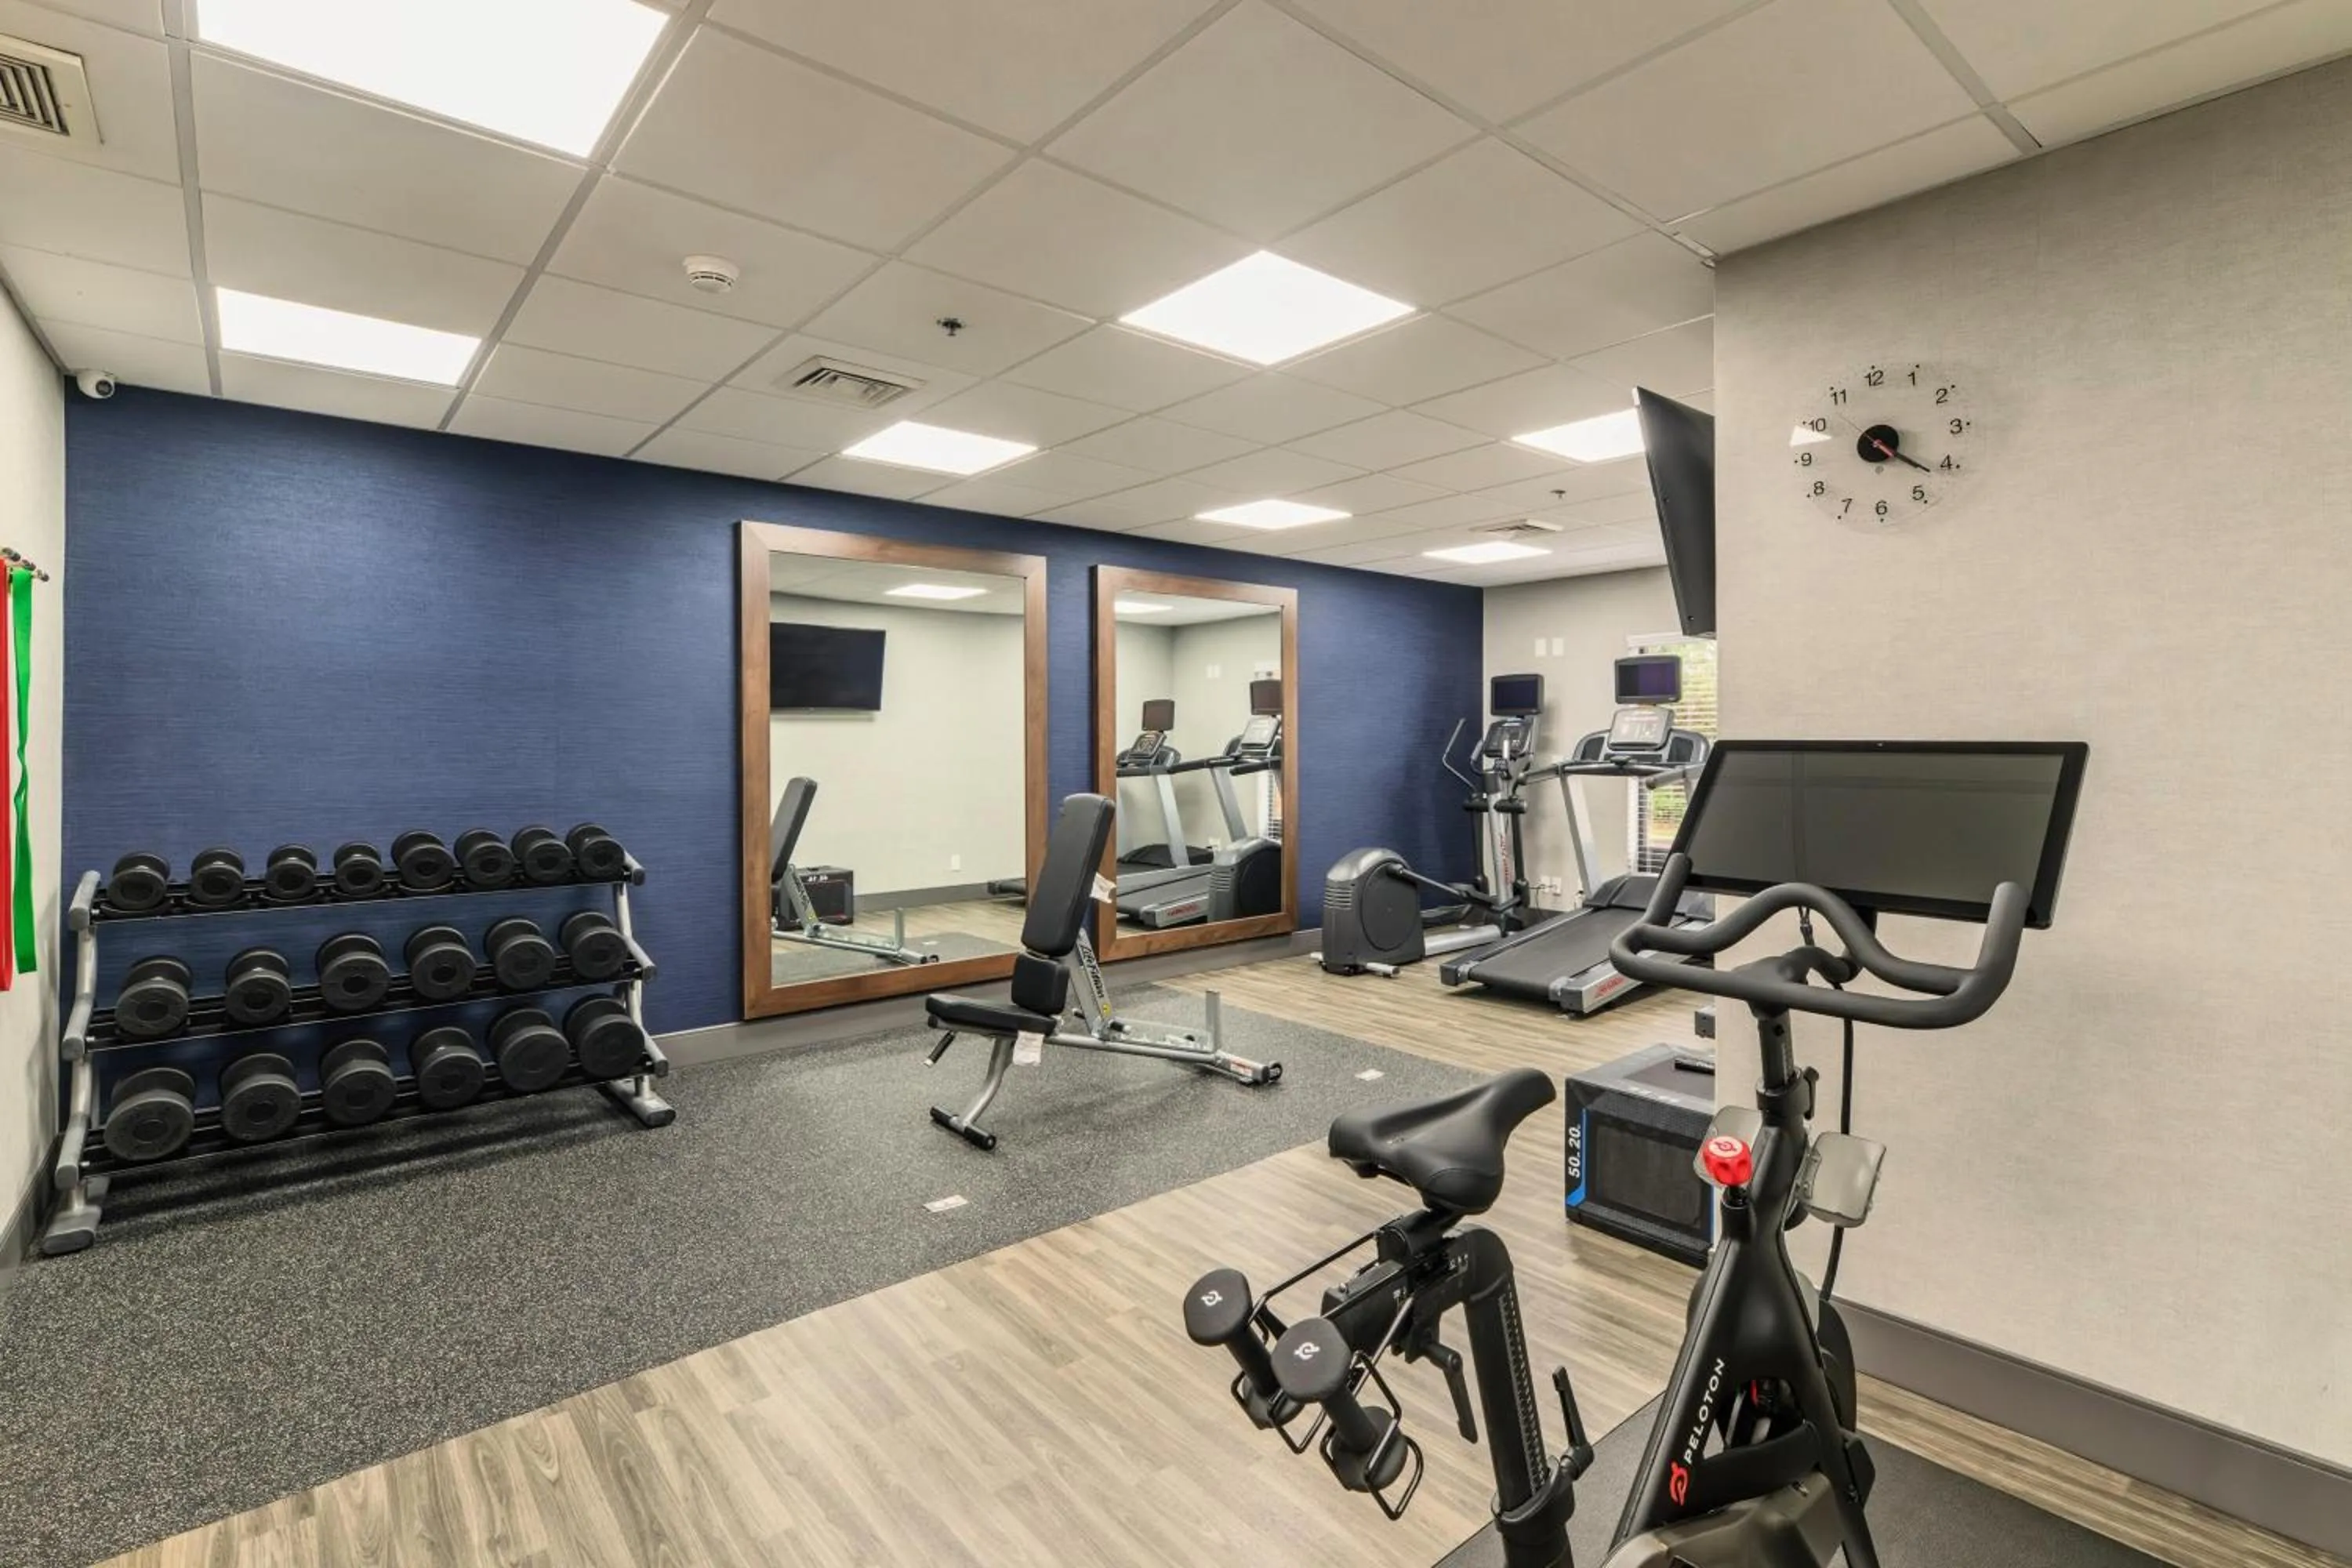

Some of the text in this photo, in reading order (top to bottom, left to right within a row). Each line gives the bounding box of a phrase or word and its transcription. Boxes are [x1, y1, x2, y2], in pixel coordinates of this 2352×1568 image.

[1864, 370, 1884, 387] 12
[1907, 372, 1915, 386] 1
[1830, 390, 1846, 405] 11
[1936, 388, 1947, 405] 2
[1809, 418, 1827, 432] 10
[1951, 419, 1962, 434] 3
[1801, 452, 1812, 466] 9
[1940, 455, 1952, 470] 4
[1813, 481, 1824, 496] 8
[1912, 485, 1925, 501] 5
[1842, 499, 1853, 514] 7
[1875, 500, 1888, 515] 6
[1684, 1358, 1725, 1465] PELOTON
